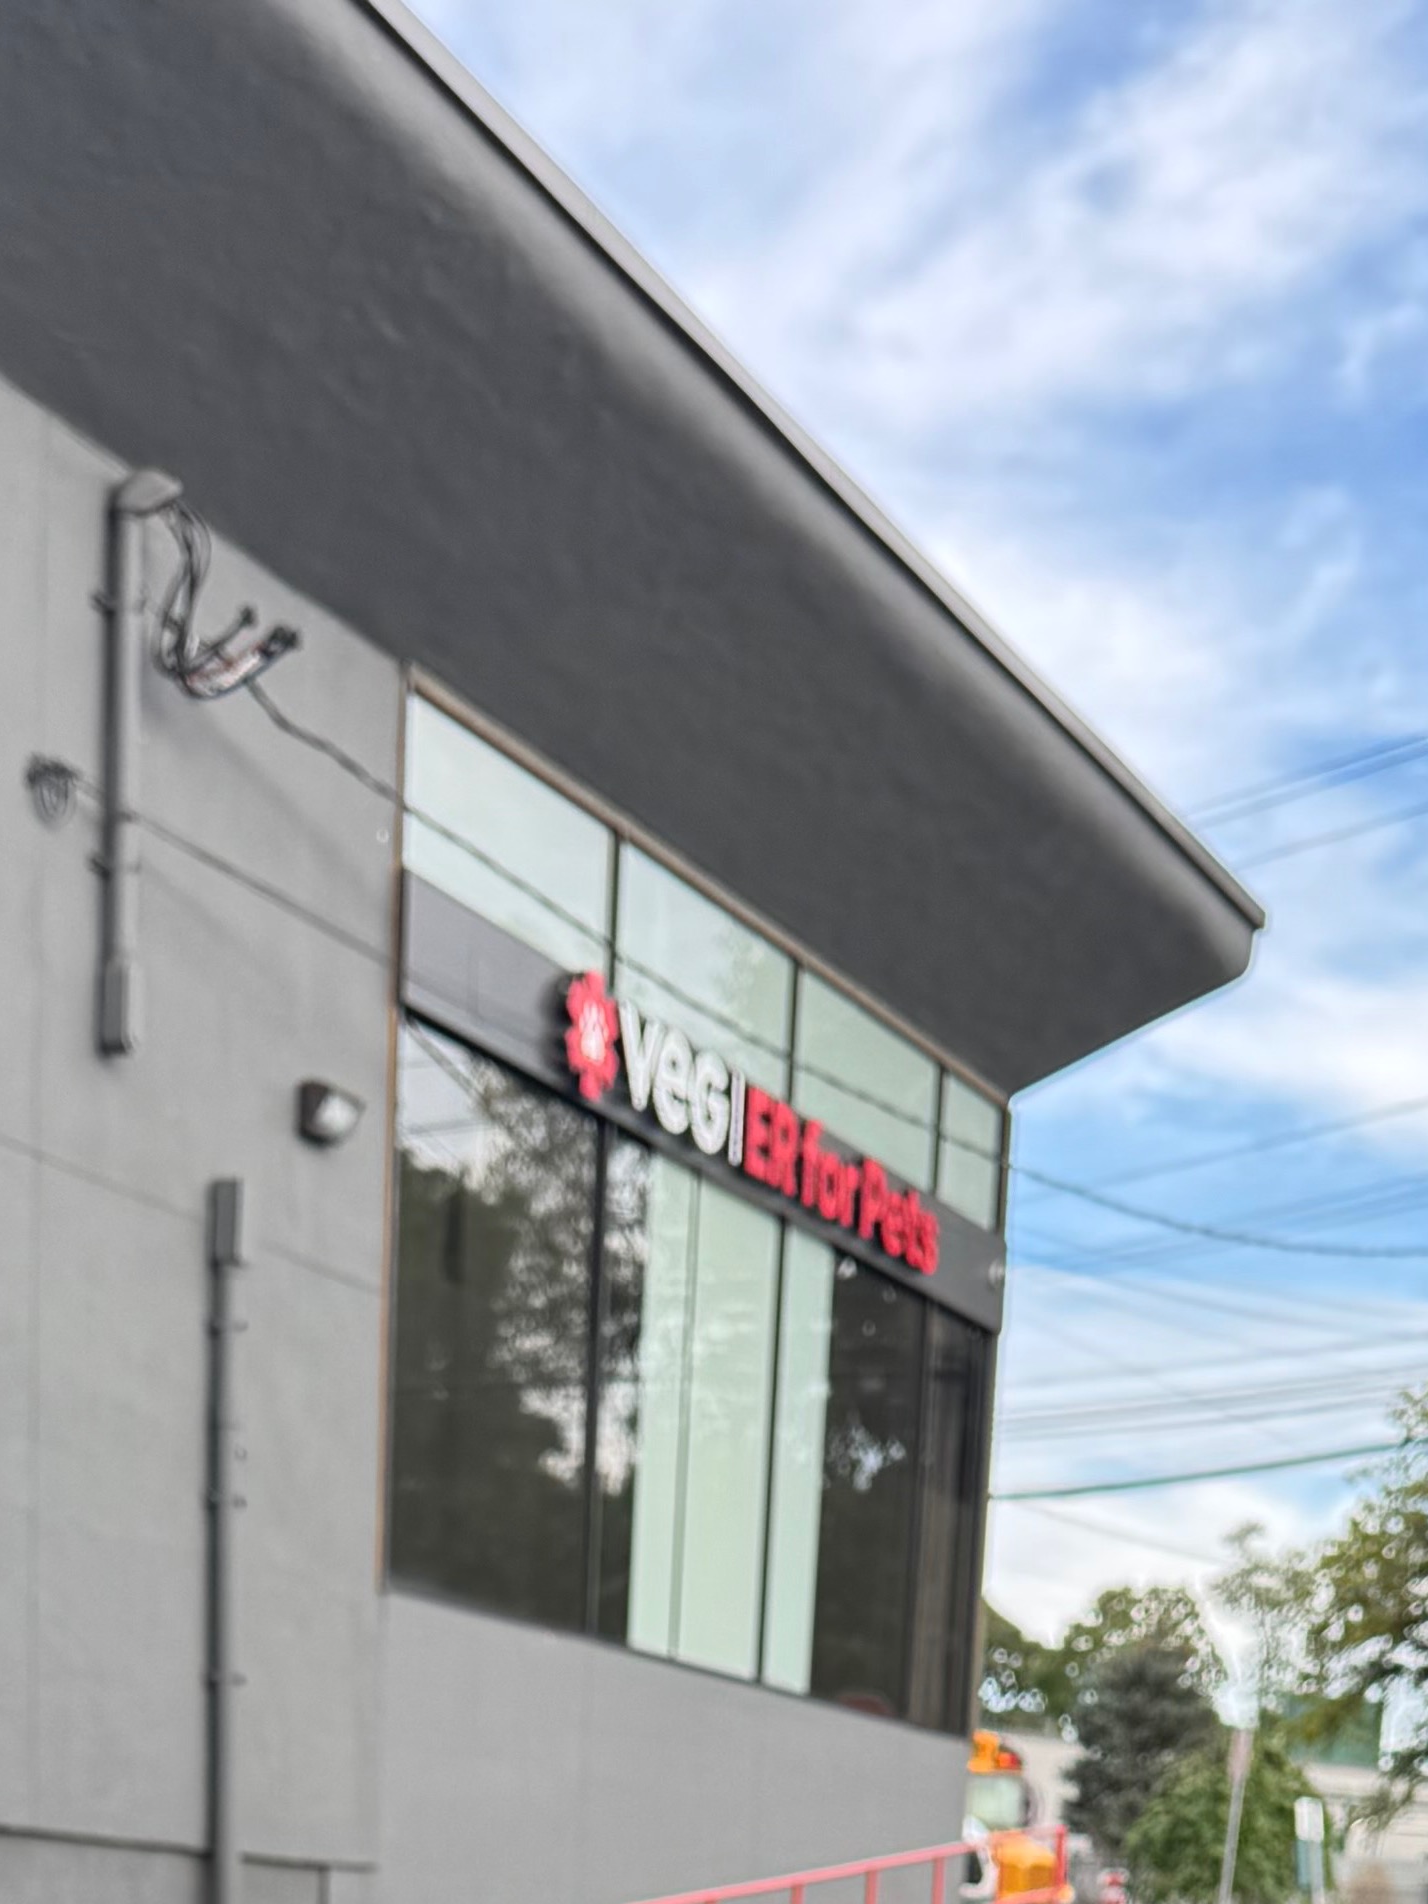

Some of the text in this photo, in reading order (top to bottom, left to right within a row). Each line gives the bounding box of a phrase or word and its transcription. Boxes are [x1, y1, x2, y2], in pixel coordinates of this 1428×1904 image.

[744, 1085, 798, 1197] ER
[800, 1118, 858, 1228] for
[858, 1156, 940, 1276] Pets
